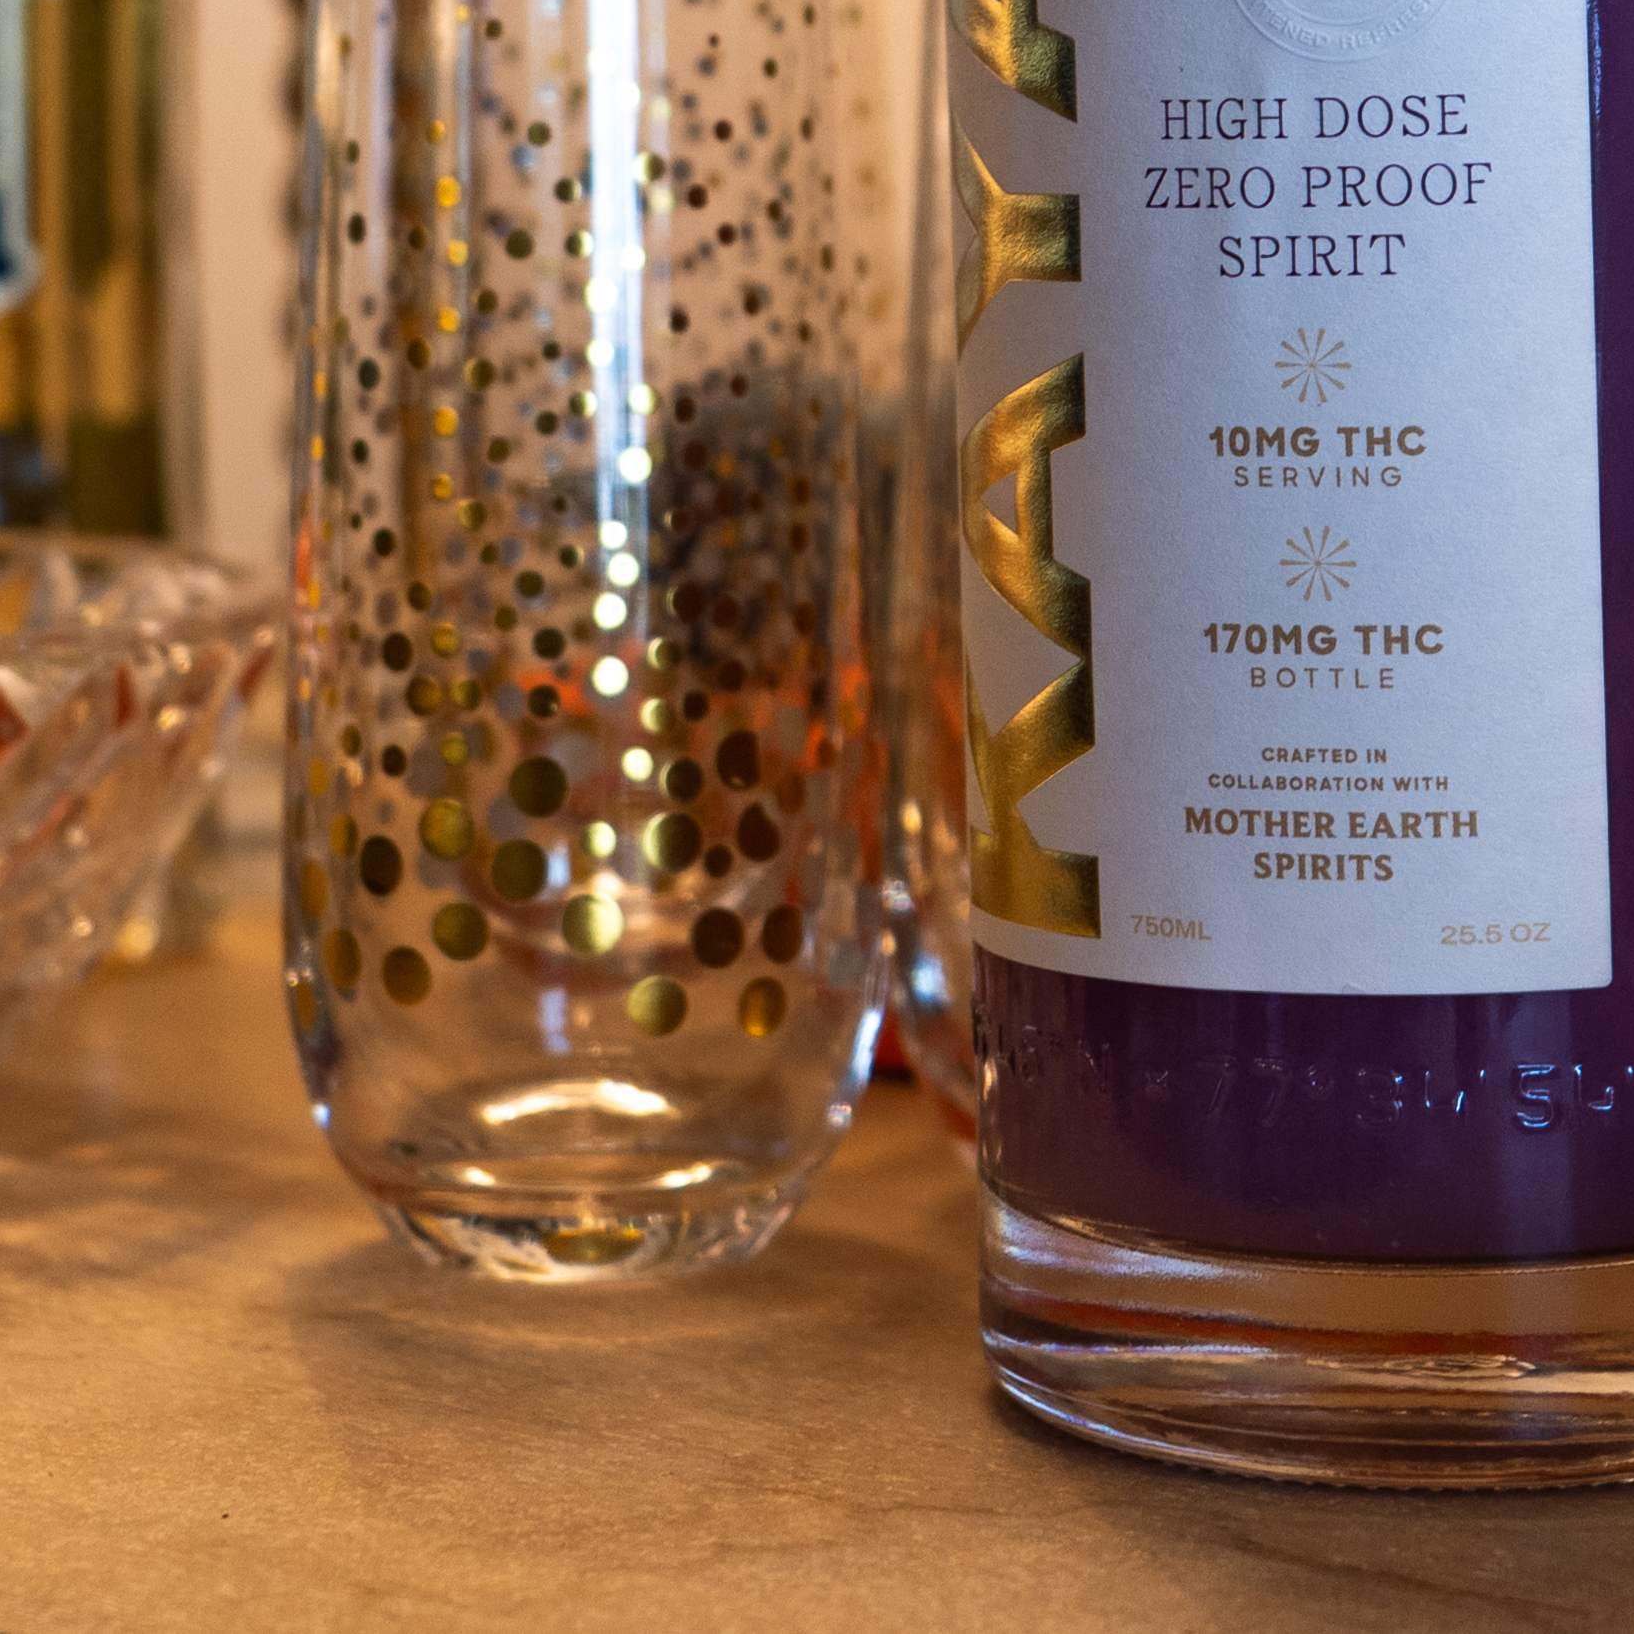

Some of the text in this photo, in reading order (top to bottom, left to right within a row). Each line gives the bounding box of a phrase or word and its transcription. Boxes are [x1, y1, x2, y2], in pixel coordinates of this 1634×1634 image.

[1159, 93, 1468, 142] HIGH DOSE
[1142, 162, 1492, 210] ZERO PROOF
[1217, 233, 1405, 279] SPIRIT
[1208, 425, 1426, 458] 10MG THC
[1233, 464, 1402, 489] SERVING
[1202, 622, 1444, 656] 170MG THC
[1248, 665, 1393, 690] BOTTLE
[1260, 746, 1388, 765] CRAFTED IN
[1206, 774, 1449, 792] COLLABORATION WITH
[1183, 805, 1478, 840] MOTHER EARTH
[1252, 850, 1394, 882] SPIRITS
[1130, 914, 1212, 941] 750ML
[1440, 921, 1551, 948] 25.5 OZ
